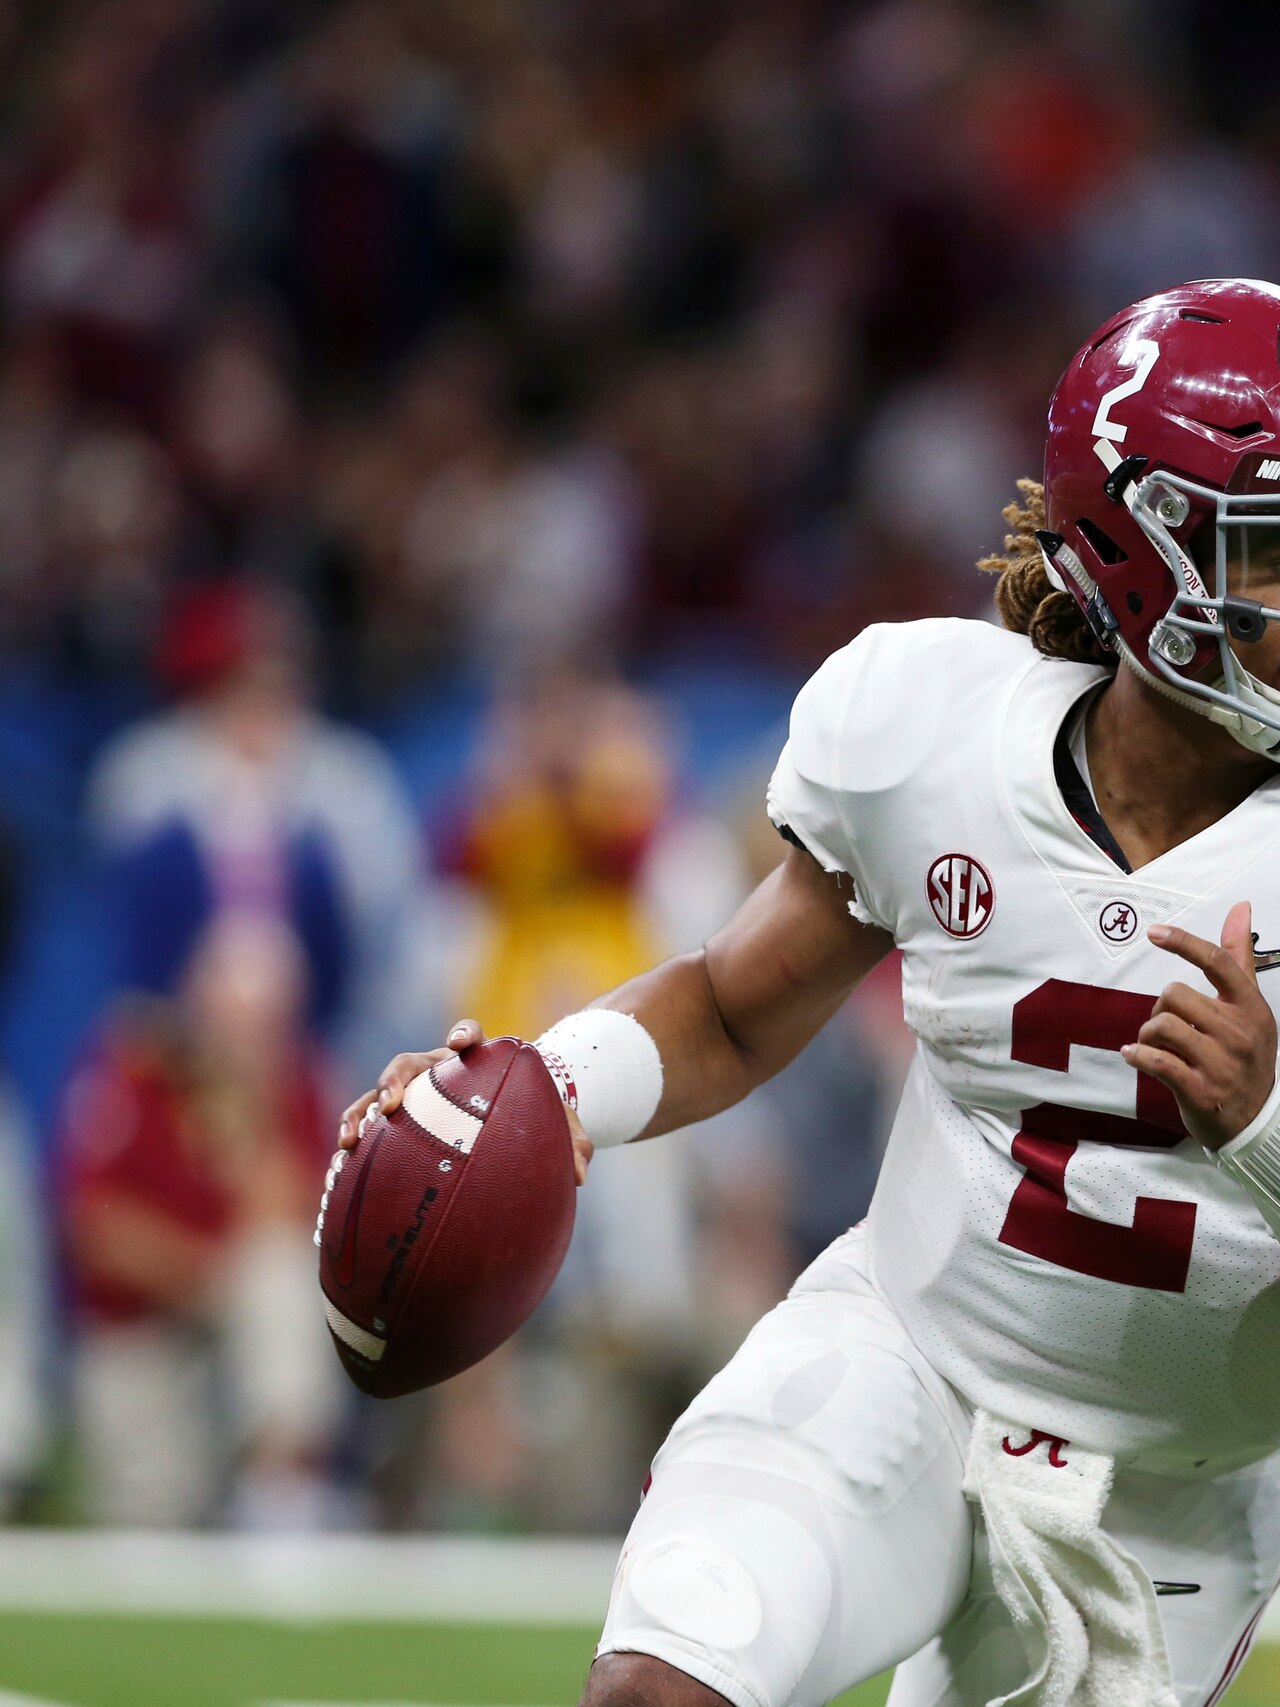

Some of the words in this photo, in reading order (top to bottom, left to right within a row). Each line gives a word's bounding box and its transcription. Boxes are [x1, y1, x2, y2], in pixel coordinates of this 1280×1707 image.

[1091, 339, 1160, 443] 2
[931, 857, 988, 932] SEC
[998, 977, 1198, 1293] 2
